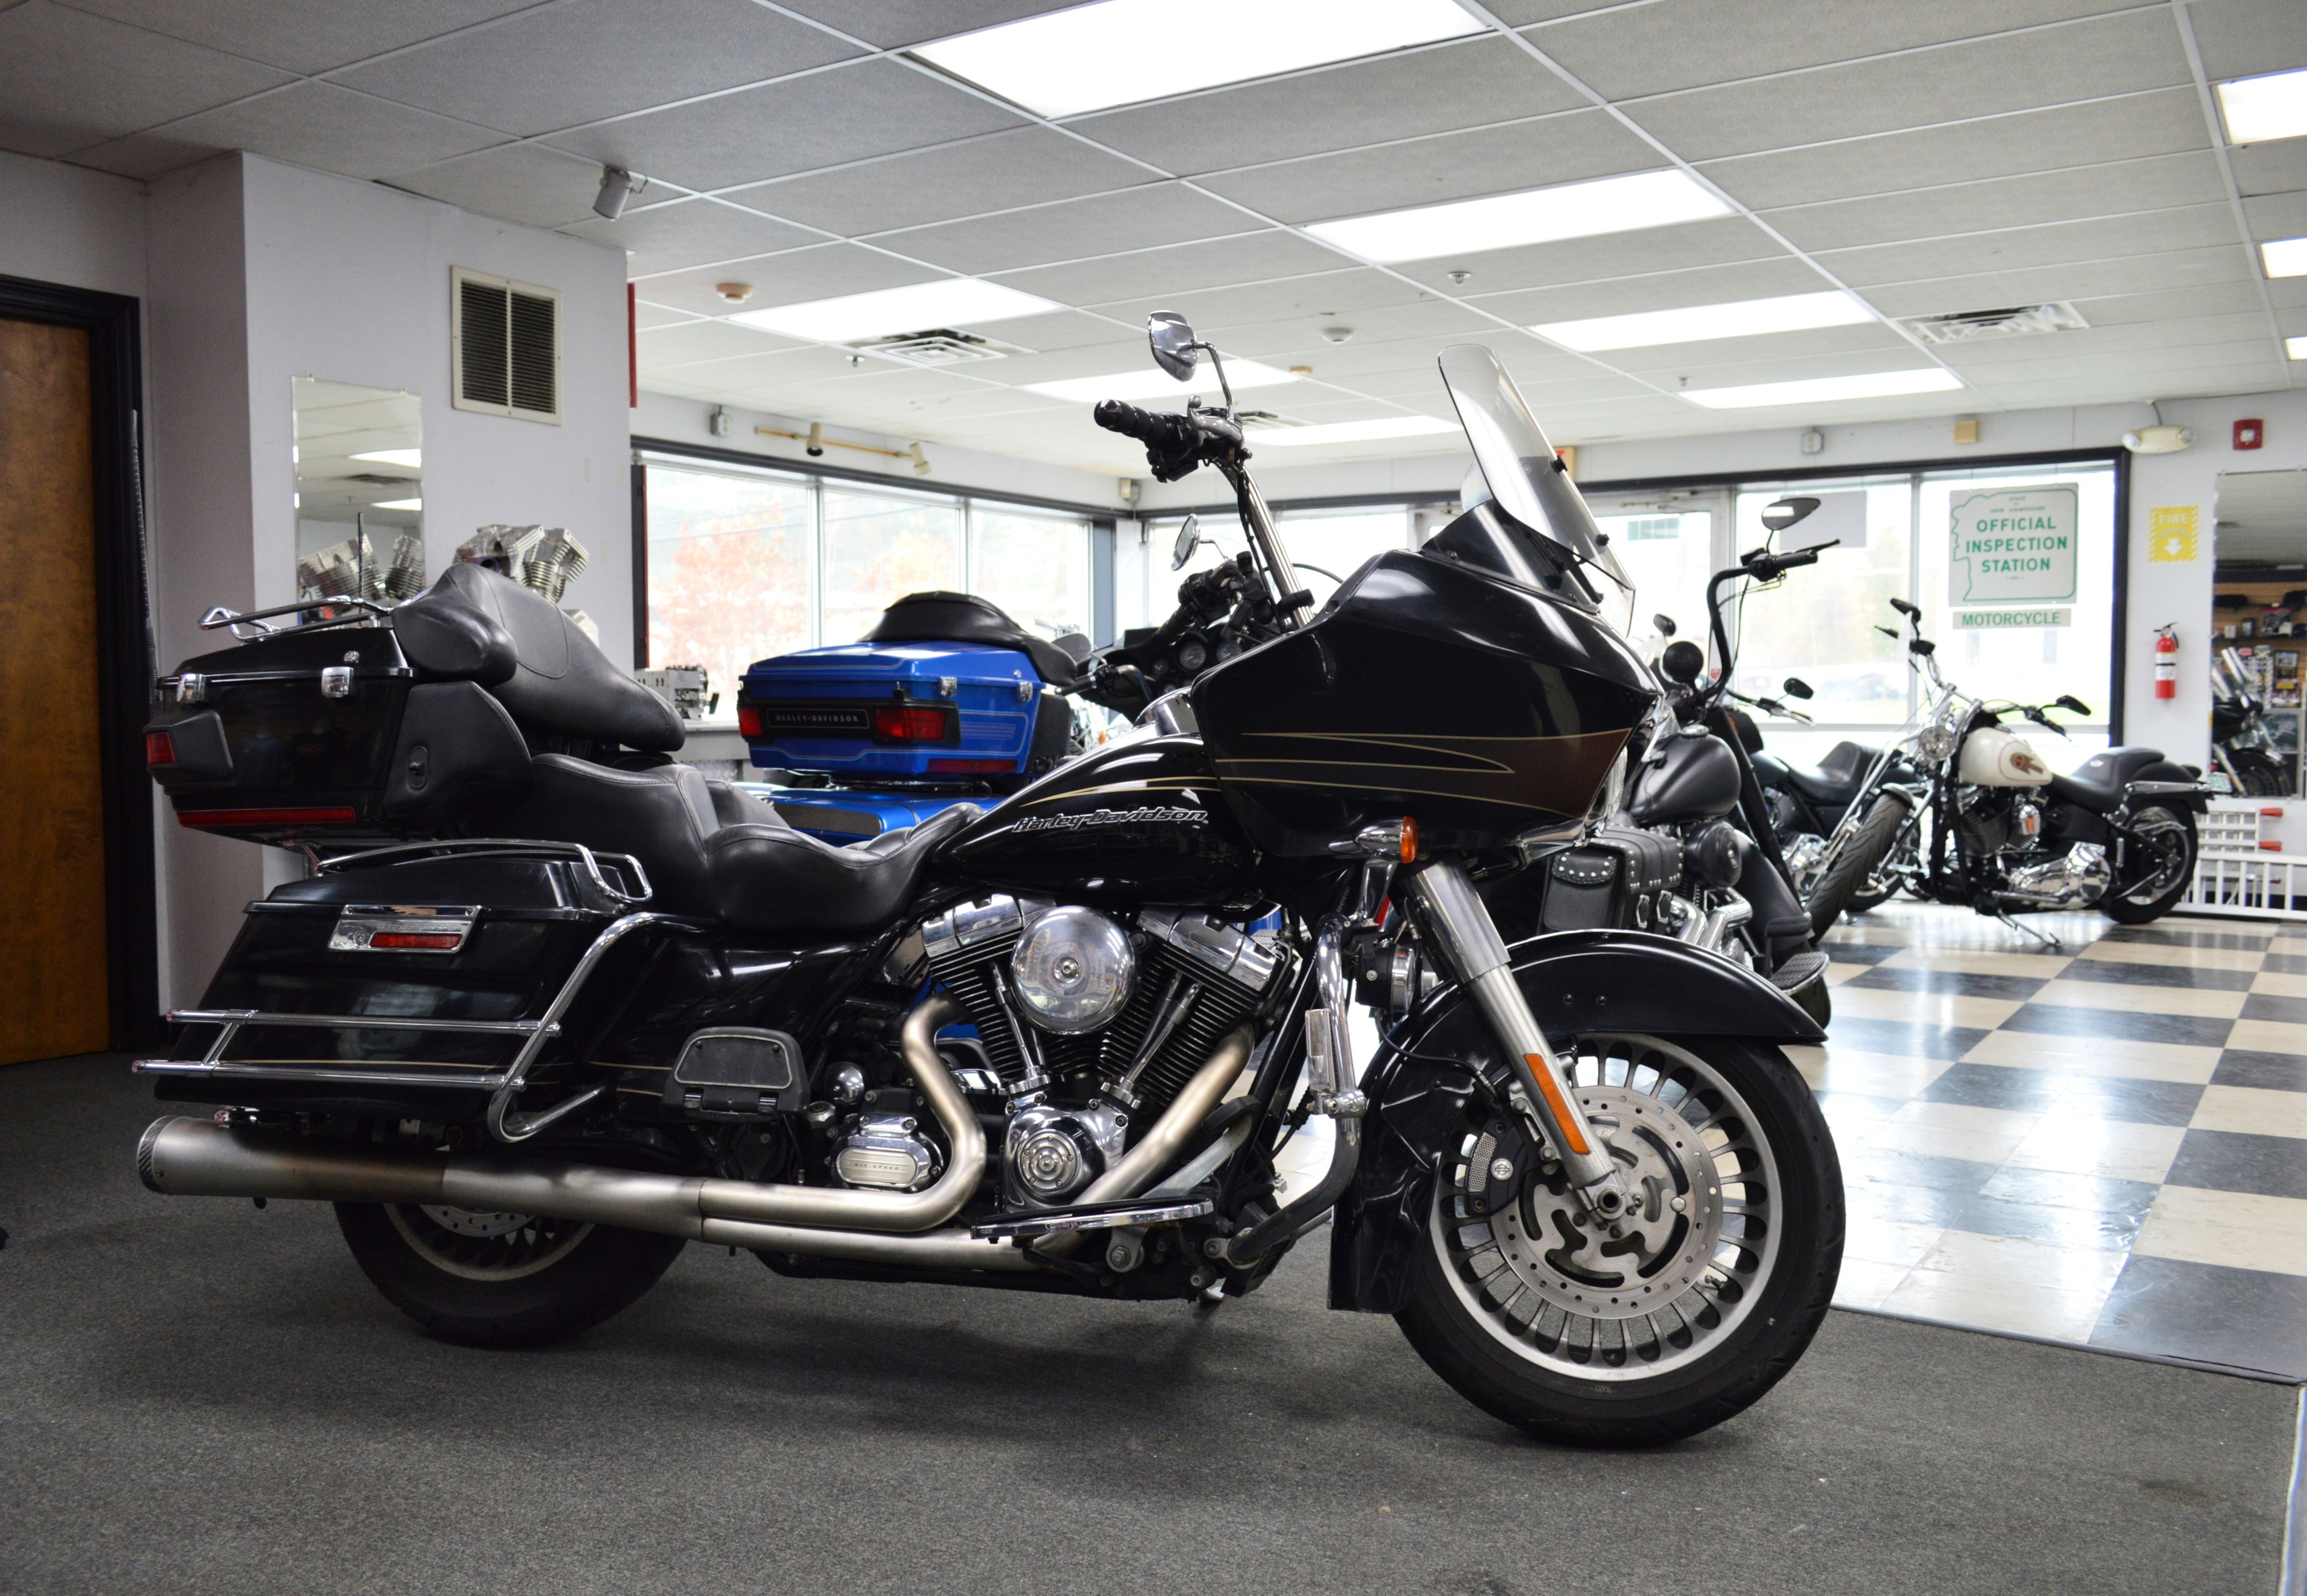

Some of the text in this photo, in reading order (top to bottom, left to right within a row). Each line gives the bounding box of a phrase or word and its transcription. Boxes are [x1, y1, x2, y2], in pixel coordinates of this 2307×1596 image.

[1977, 517, 2056, 532] OFFICIAL
[2159, 513, 2188, 524] FIRE
[1966, 536, 2067, 553] INSPECTION
[1982, 558, 2050, 573] STATION
[1962, 611, 2060, 626] MOTORCYCLE
[1012, 806, 1208, 833] Harley-Davidson
